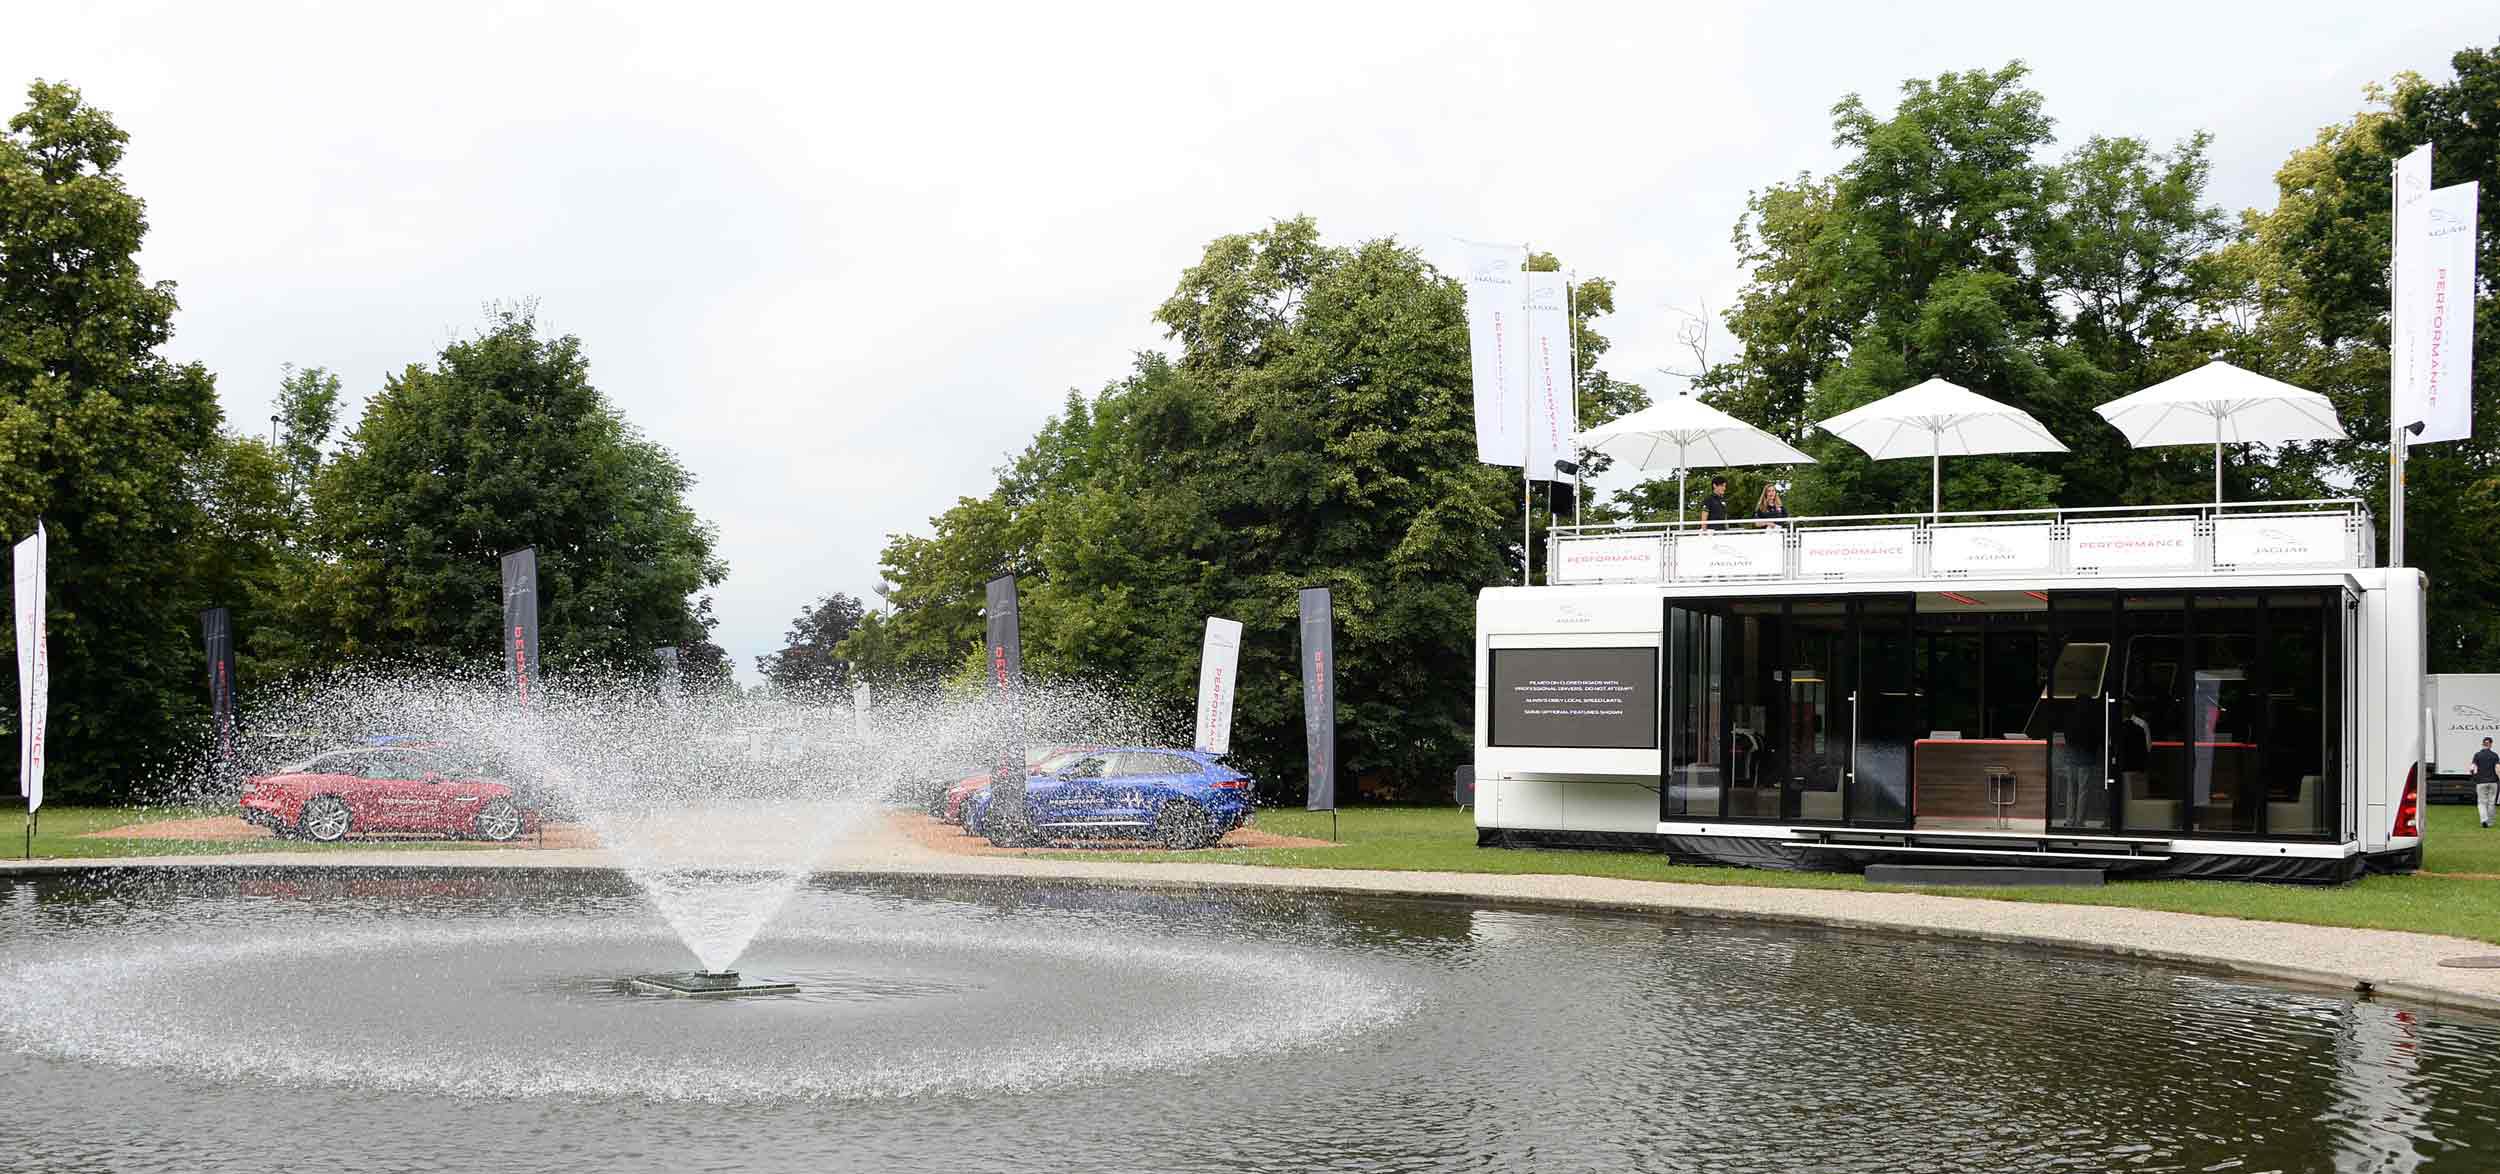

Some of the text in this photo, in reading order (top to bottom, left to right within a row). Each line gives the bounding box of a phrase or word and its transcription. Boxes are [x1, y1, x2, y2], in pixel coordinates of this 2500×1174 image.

[2430, 268, 2447, 407] PERFORMANCE
[2080, 538, 2184, 548] PERFORMANCE
[1809, 547, 1904, 557] PERFORMANCE
[1568, 554, 1651, 563] PERFORMANCE
[1208, 667, 1222, 752] PERFORMANC
